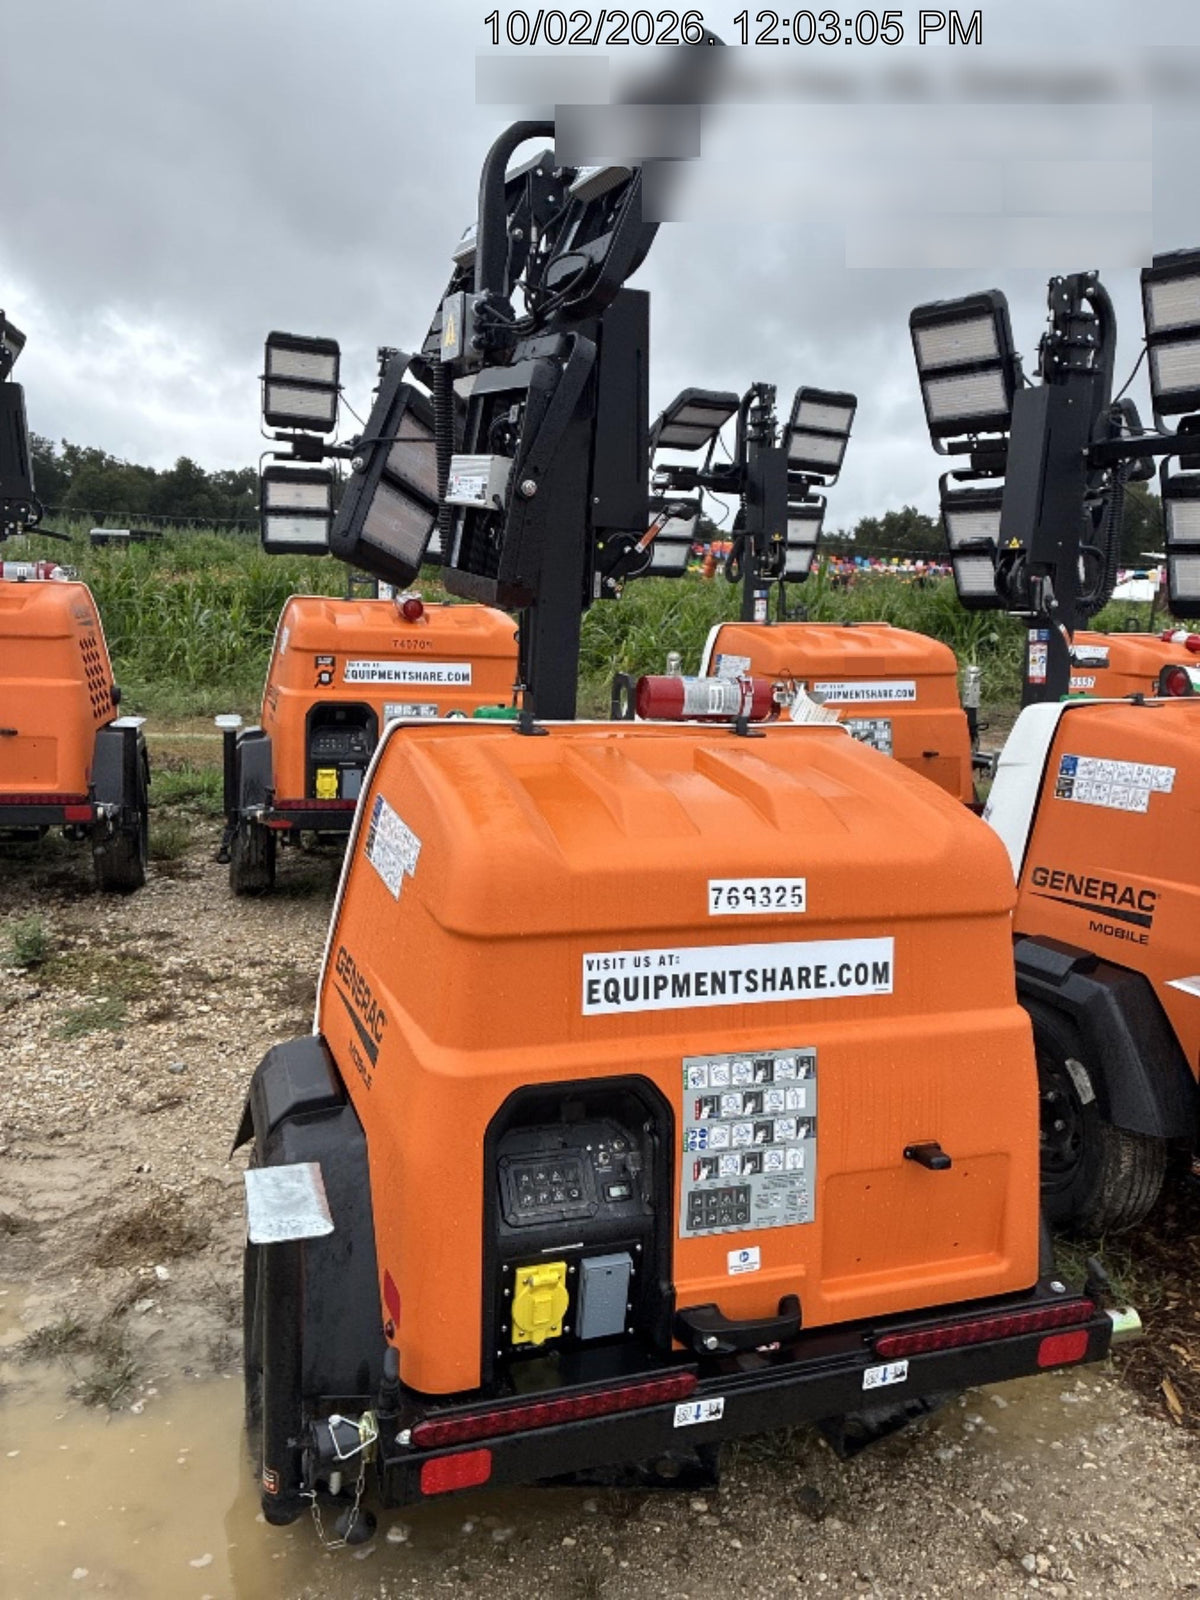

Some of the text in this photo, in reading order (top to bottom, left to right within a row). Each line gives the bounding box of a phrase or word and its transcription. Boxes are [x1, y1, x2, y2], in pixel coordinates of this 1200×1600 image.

[711, 885, 803, 909] 769325
[1031, 866, 1157, 912] GENERAC
[1089, 920, 1149, 945] MOBILE
[586, 954, 680, 971] VISIT US AT:
[335, 945, 386, 1043] GENERAC
[586, 961, 890, 1005] EQUIPMENTSHARE.COM
